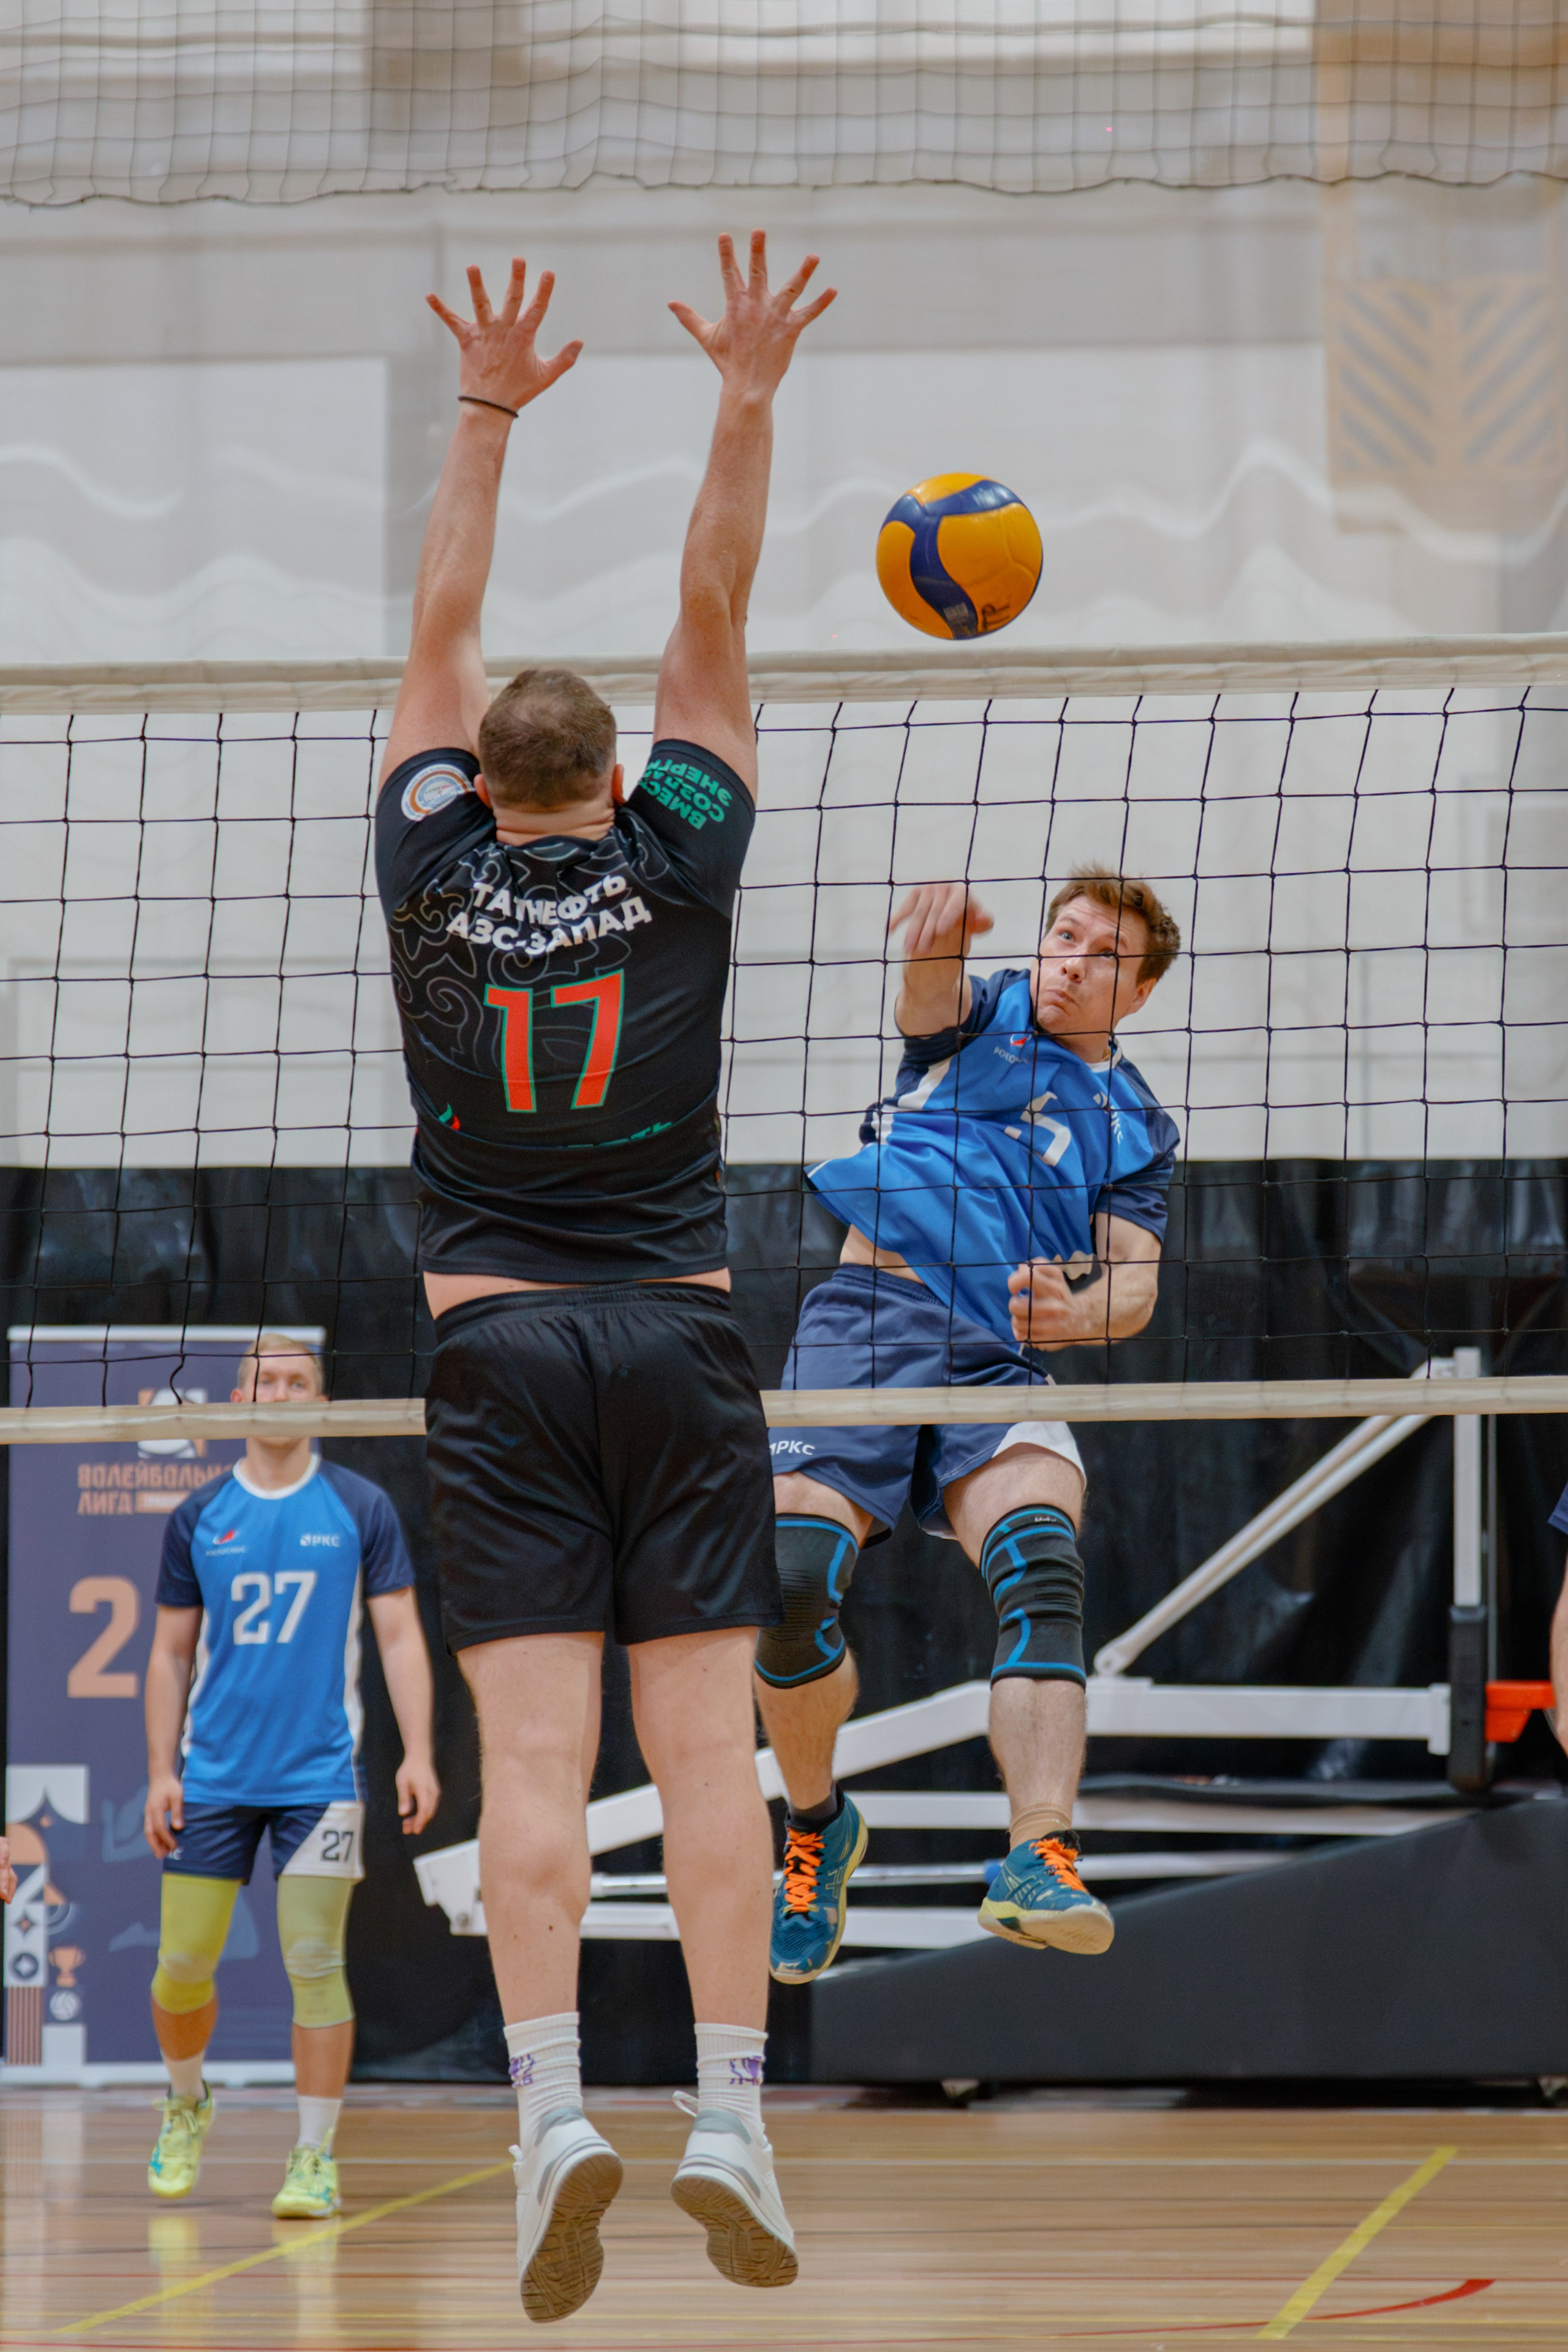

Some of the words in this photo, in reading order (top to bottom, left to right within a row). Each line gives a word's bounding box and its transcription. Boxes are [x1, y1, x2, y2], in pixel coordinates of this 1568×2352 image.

[446, 896, 652, 956] АЗС-ЗАПАД
[473, 875, 627, 925] ТАТНЕФТЬ
[483, 969, 624, 1113] 17
[78, 1461, 233, 1489] ВОЛЕЙБОЛЬН
[78, 1491, 134, 1515] ЛИГА
[231, 1570, 317, 1645] 27
[67, 1575, 140, 1698] 2
[321, 1830, 353, 1862] 27
